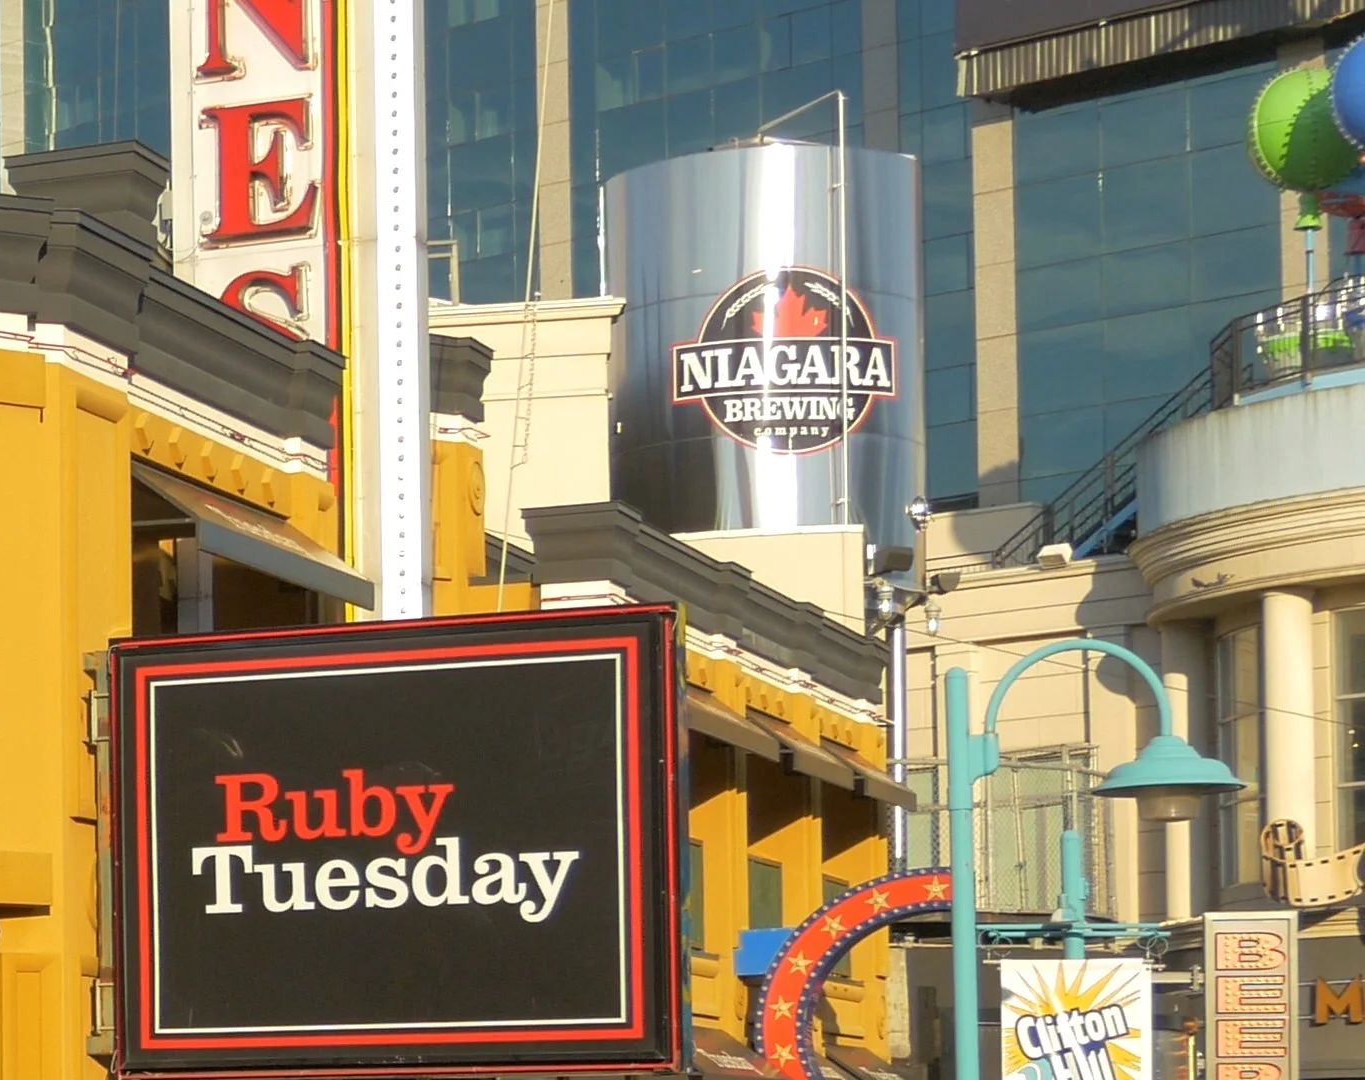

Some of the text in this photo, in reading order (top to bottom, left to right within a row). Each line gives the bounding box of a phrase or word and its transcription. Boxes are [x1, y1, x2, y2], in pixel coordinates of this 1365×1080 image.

[680, 345, 891, 392] NIAGARA
[723, 397, 855, 423] BREWING
[754, 425, 830, 437] company
[214, 768, 455, 855] Ruby
[191, 836, 579, 924] Tuesday
